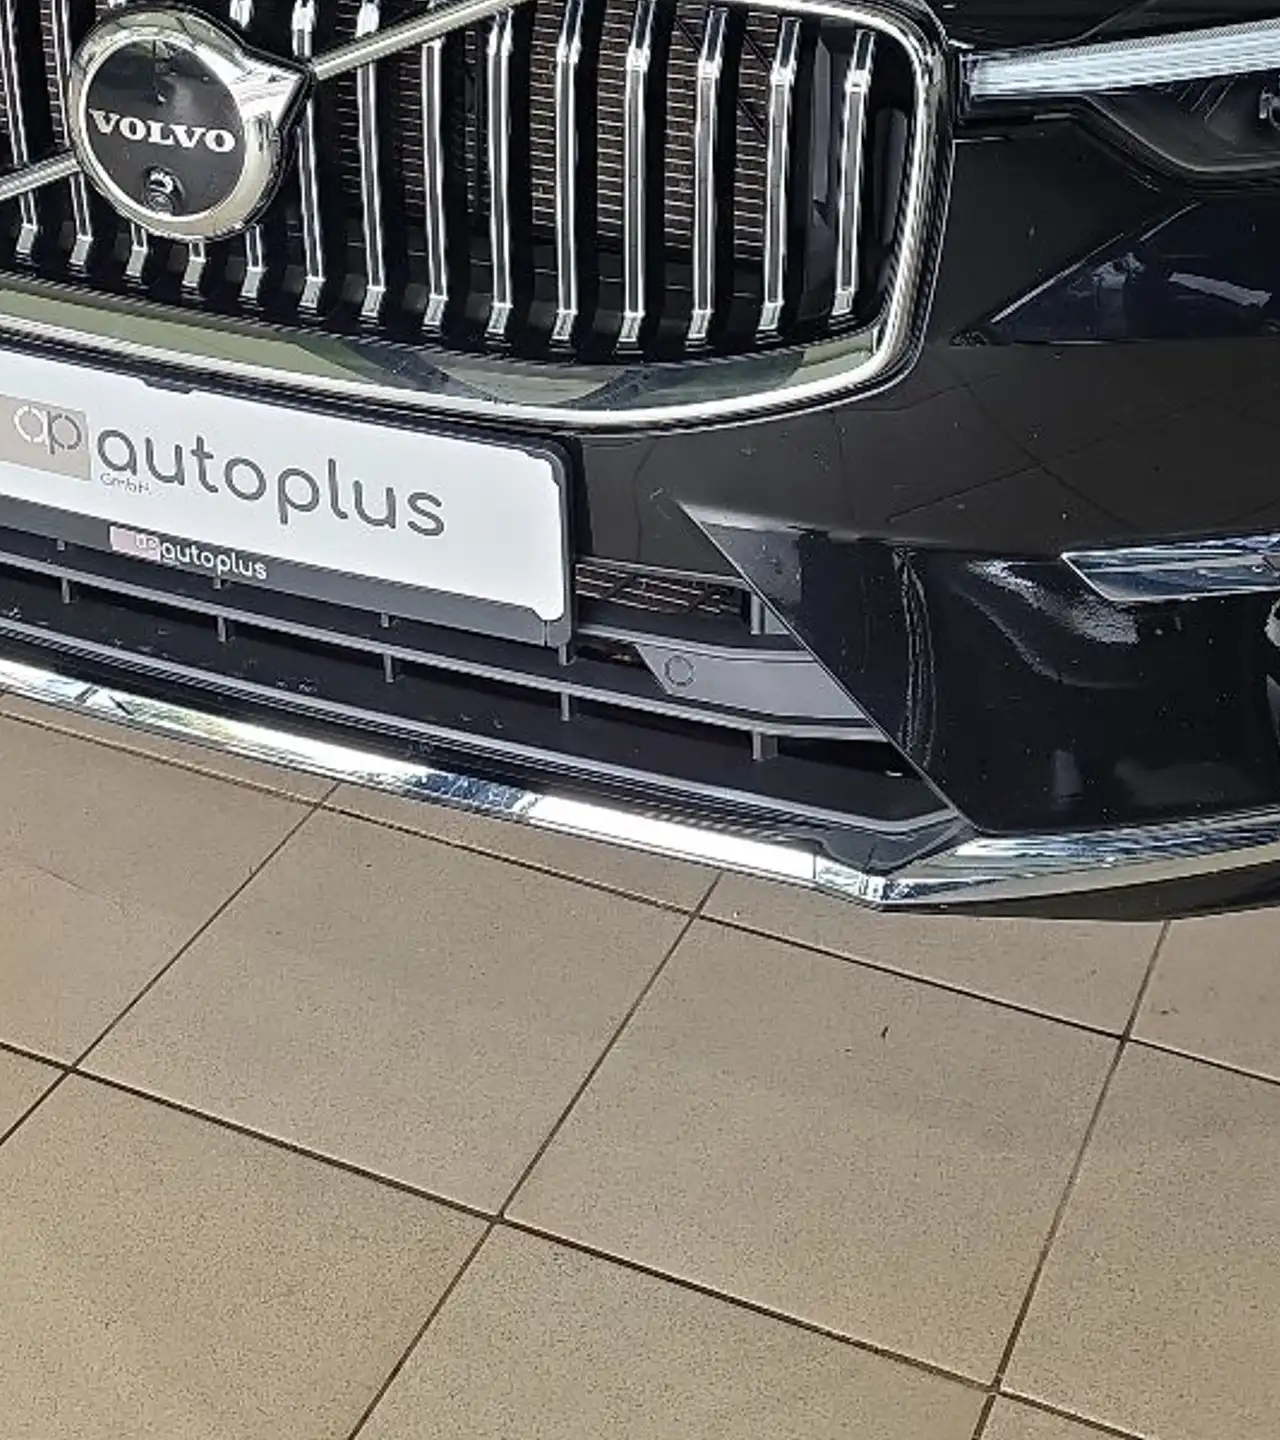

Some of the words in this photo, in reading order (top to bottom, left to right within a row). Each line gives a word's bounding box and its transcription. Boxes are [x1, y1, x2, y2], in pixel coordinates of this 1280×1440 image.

[88, 108, 237, 153] VOLVO
[97, 429, 445, 537] autoplus
[162, 542, 268, 580] autoplus
